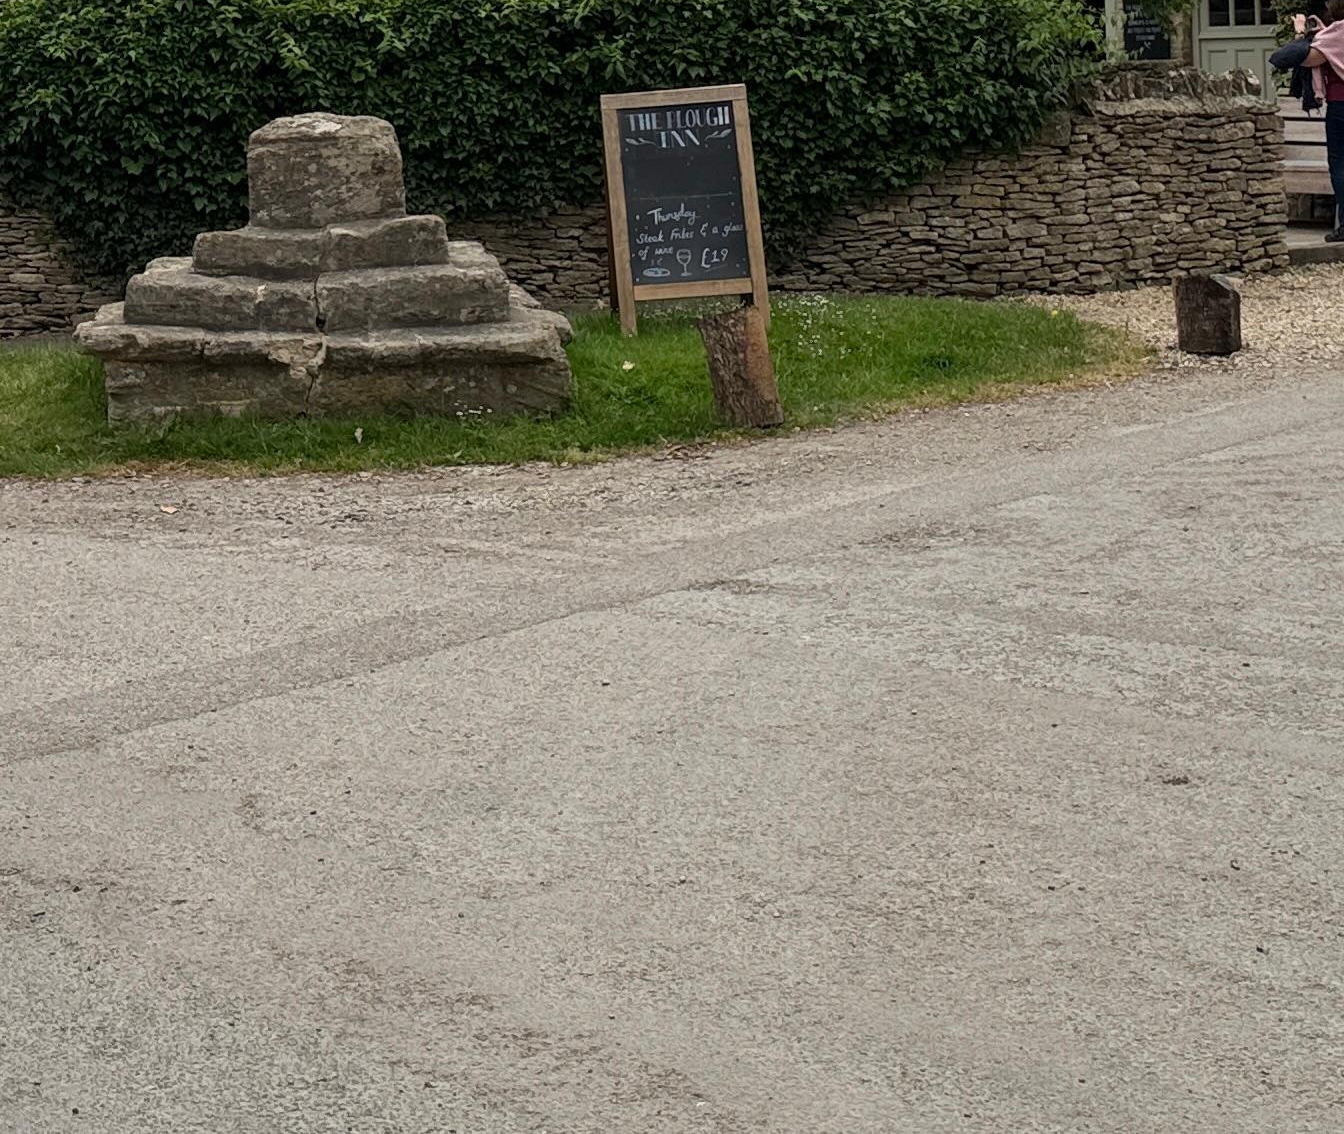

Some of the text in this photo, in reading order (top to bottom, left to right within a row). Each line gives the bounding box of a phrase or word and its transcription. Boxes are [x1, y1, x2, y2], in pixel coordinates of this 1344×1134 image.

[629, 106, 730, 131] THE PLOUGH
[659, 130, 700, 148] INN
[647, 203, 696, 225] Thursday
[637, 230, 664, 244] Steak
[638, 247, 650, 260] of
[701, 248, 728, 268] £19
